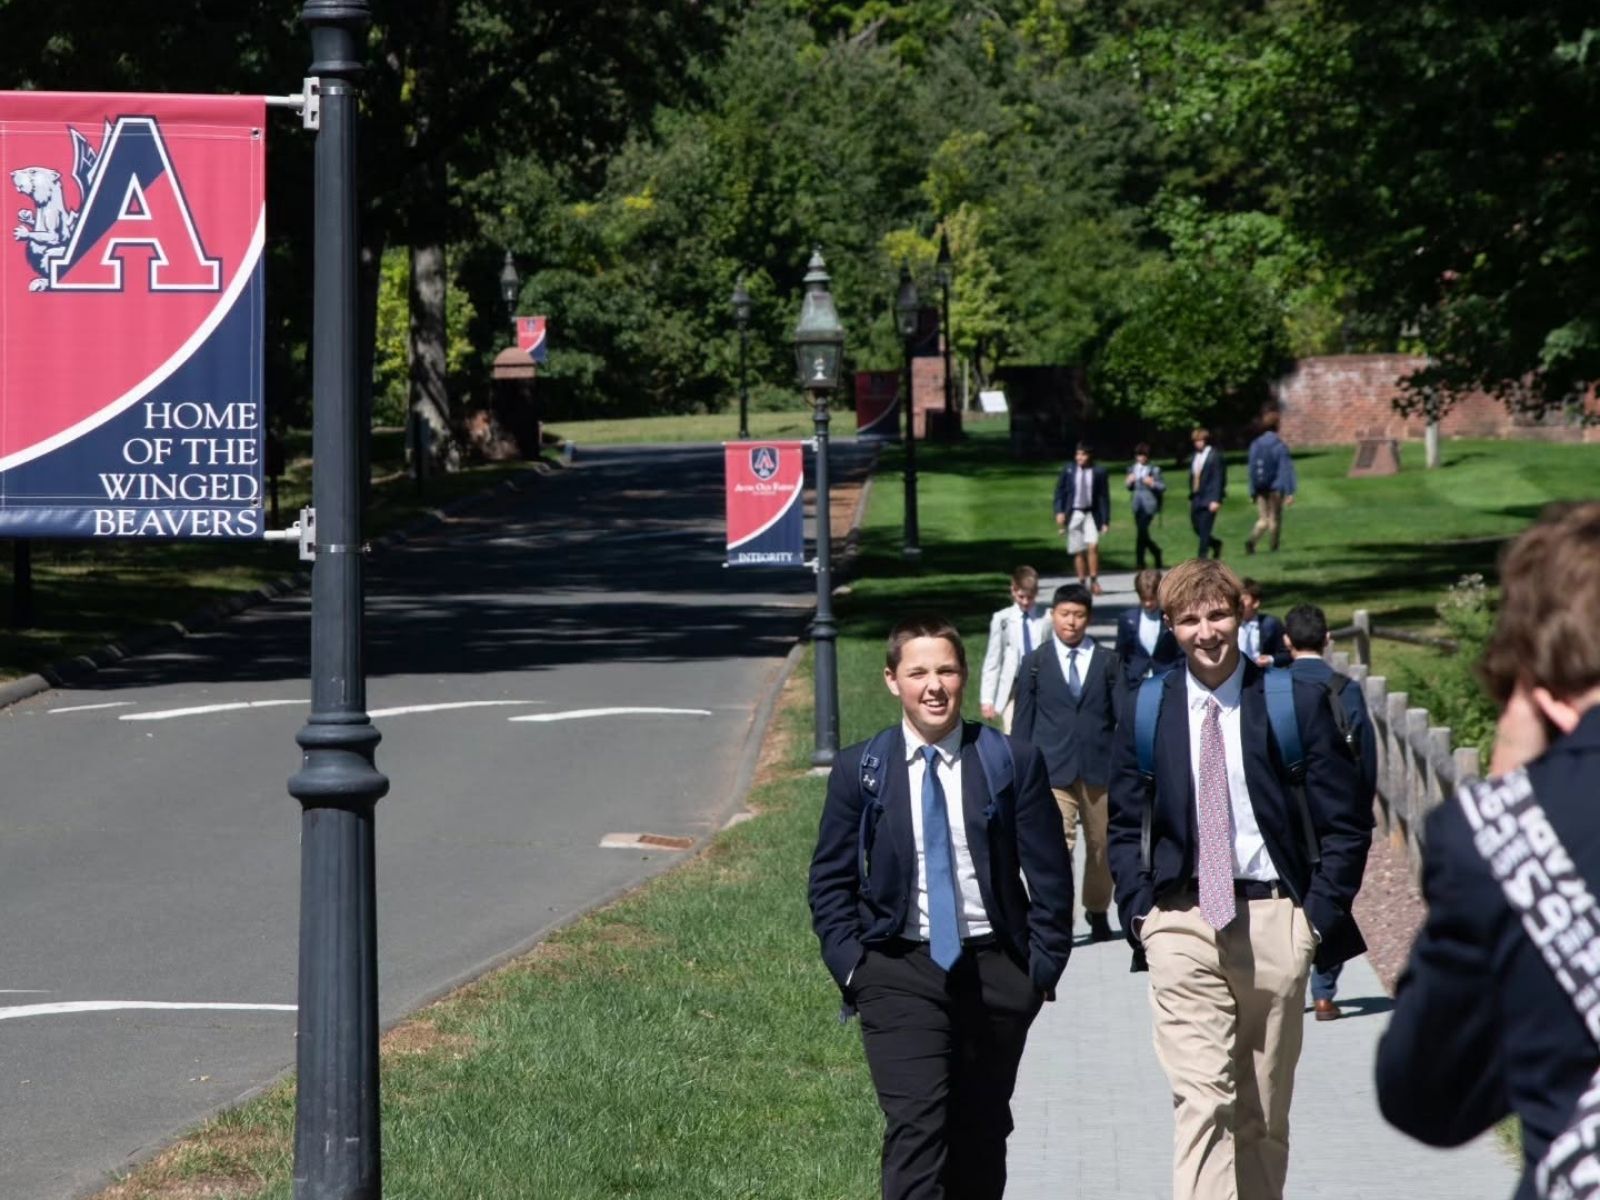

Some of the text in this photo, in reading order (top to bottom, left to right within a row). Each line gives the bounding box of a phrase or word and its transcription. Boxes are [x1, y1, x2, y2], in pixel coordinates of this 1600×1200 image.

[50, 116, 223, 293] A
[144, 402, 258, 430] HOME
[123, 438, 258, 465] OF THE
[98, 473, 259, 501] WINGED
[93, 509, 258, 537] BEAVERS
